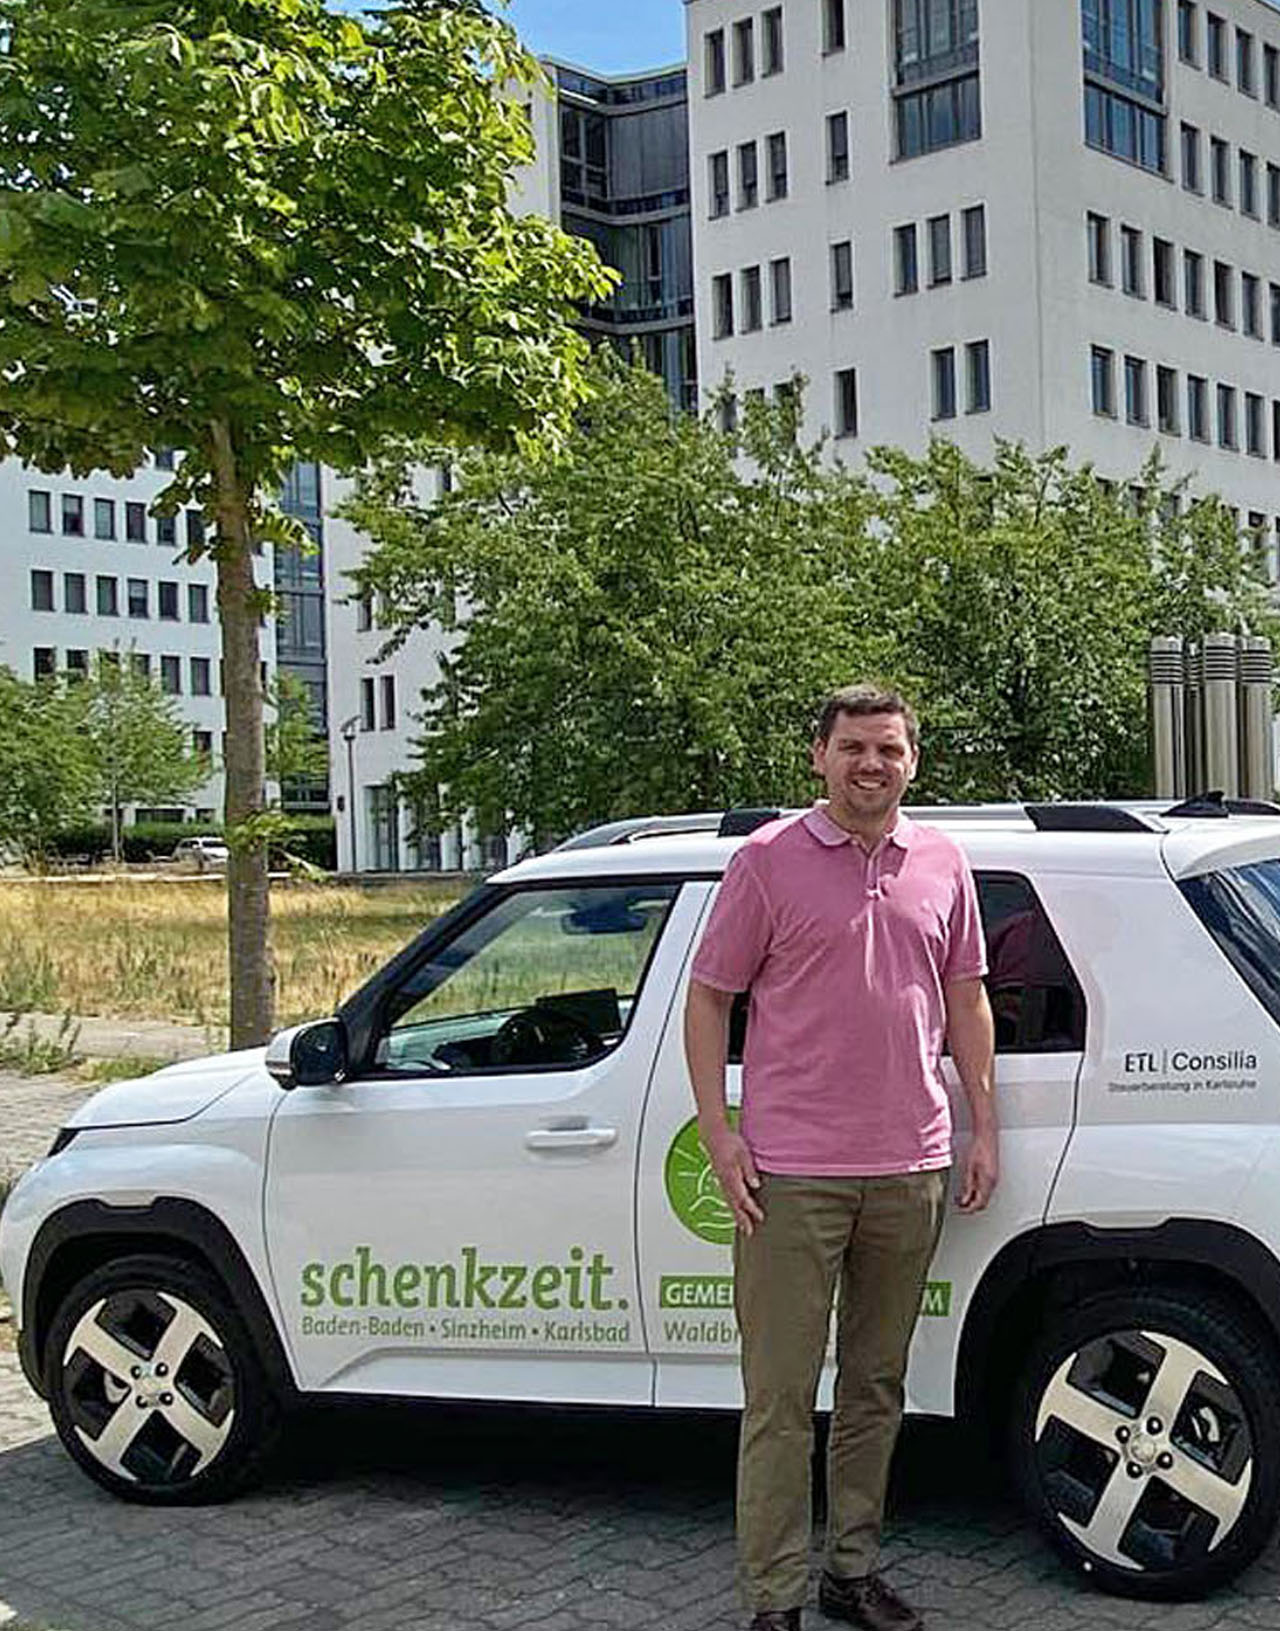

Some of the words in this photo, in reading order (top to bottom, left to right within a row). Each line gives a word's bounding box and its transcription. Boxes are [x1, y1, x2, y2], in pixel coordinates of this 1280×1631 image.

[1124, 1052, 1159, 1072] ETL
[1172, 1050, 1257, 1071] Consilia
[300, 1247, 629, 1311] schenkzeit.
[666, 1282, 734, 1305] GEMEI
[301, 1315, 425, 1338] Baden-Baden
[440, 1317, 527, 1341] Sinzheim
[544, 1319, 630, 1344] Karlsbad
